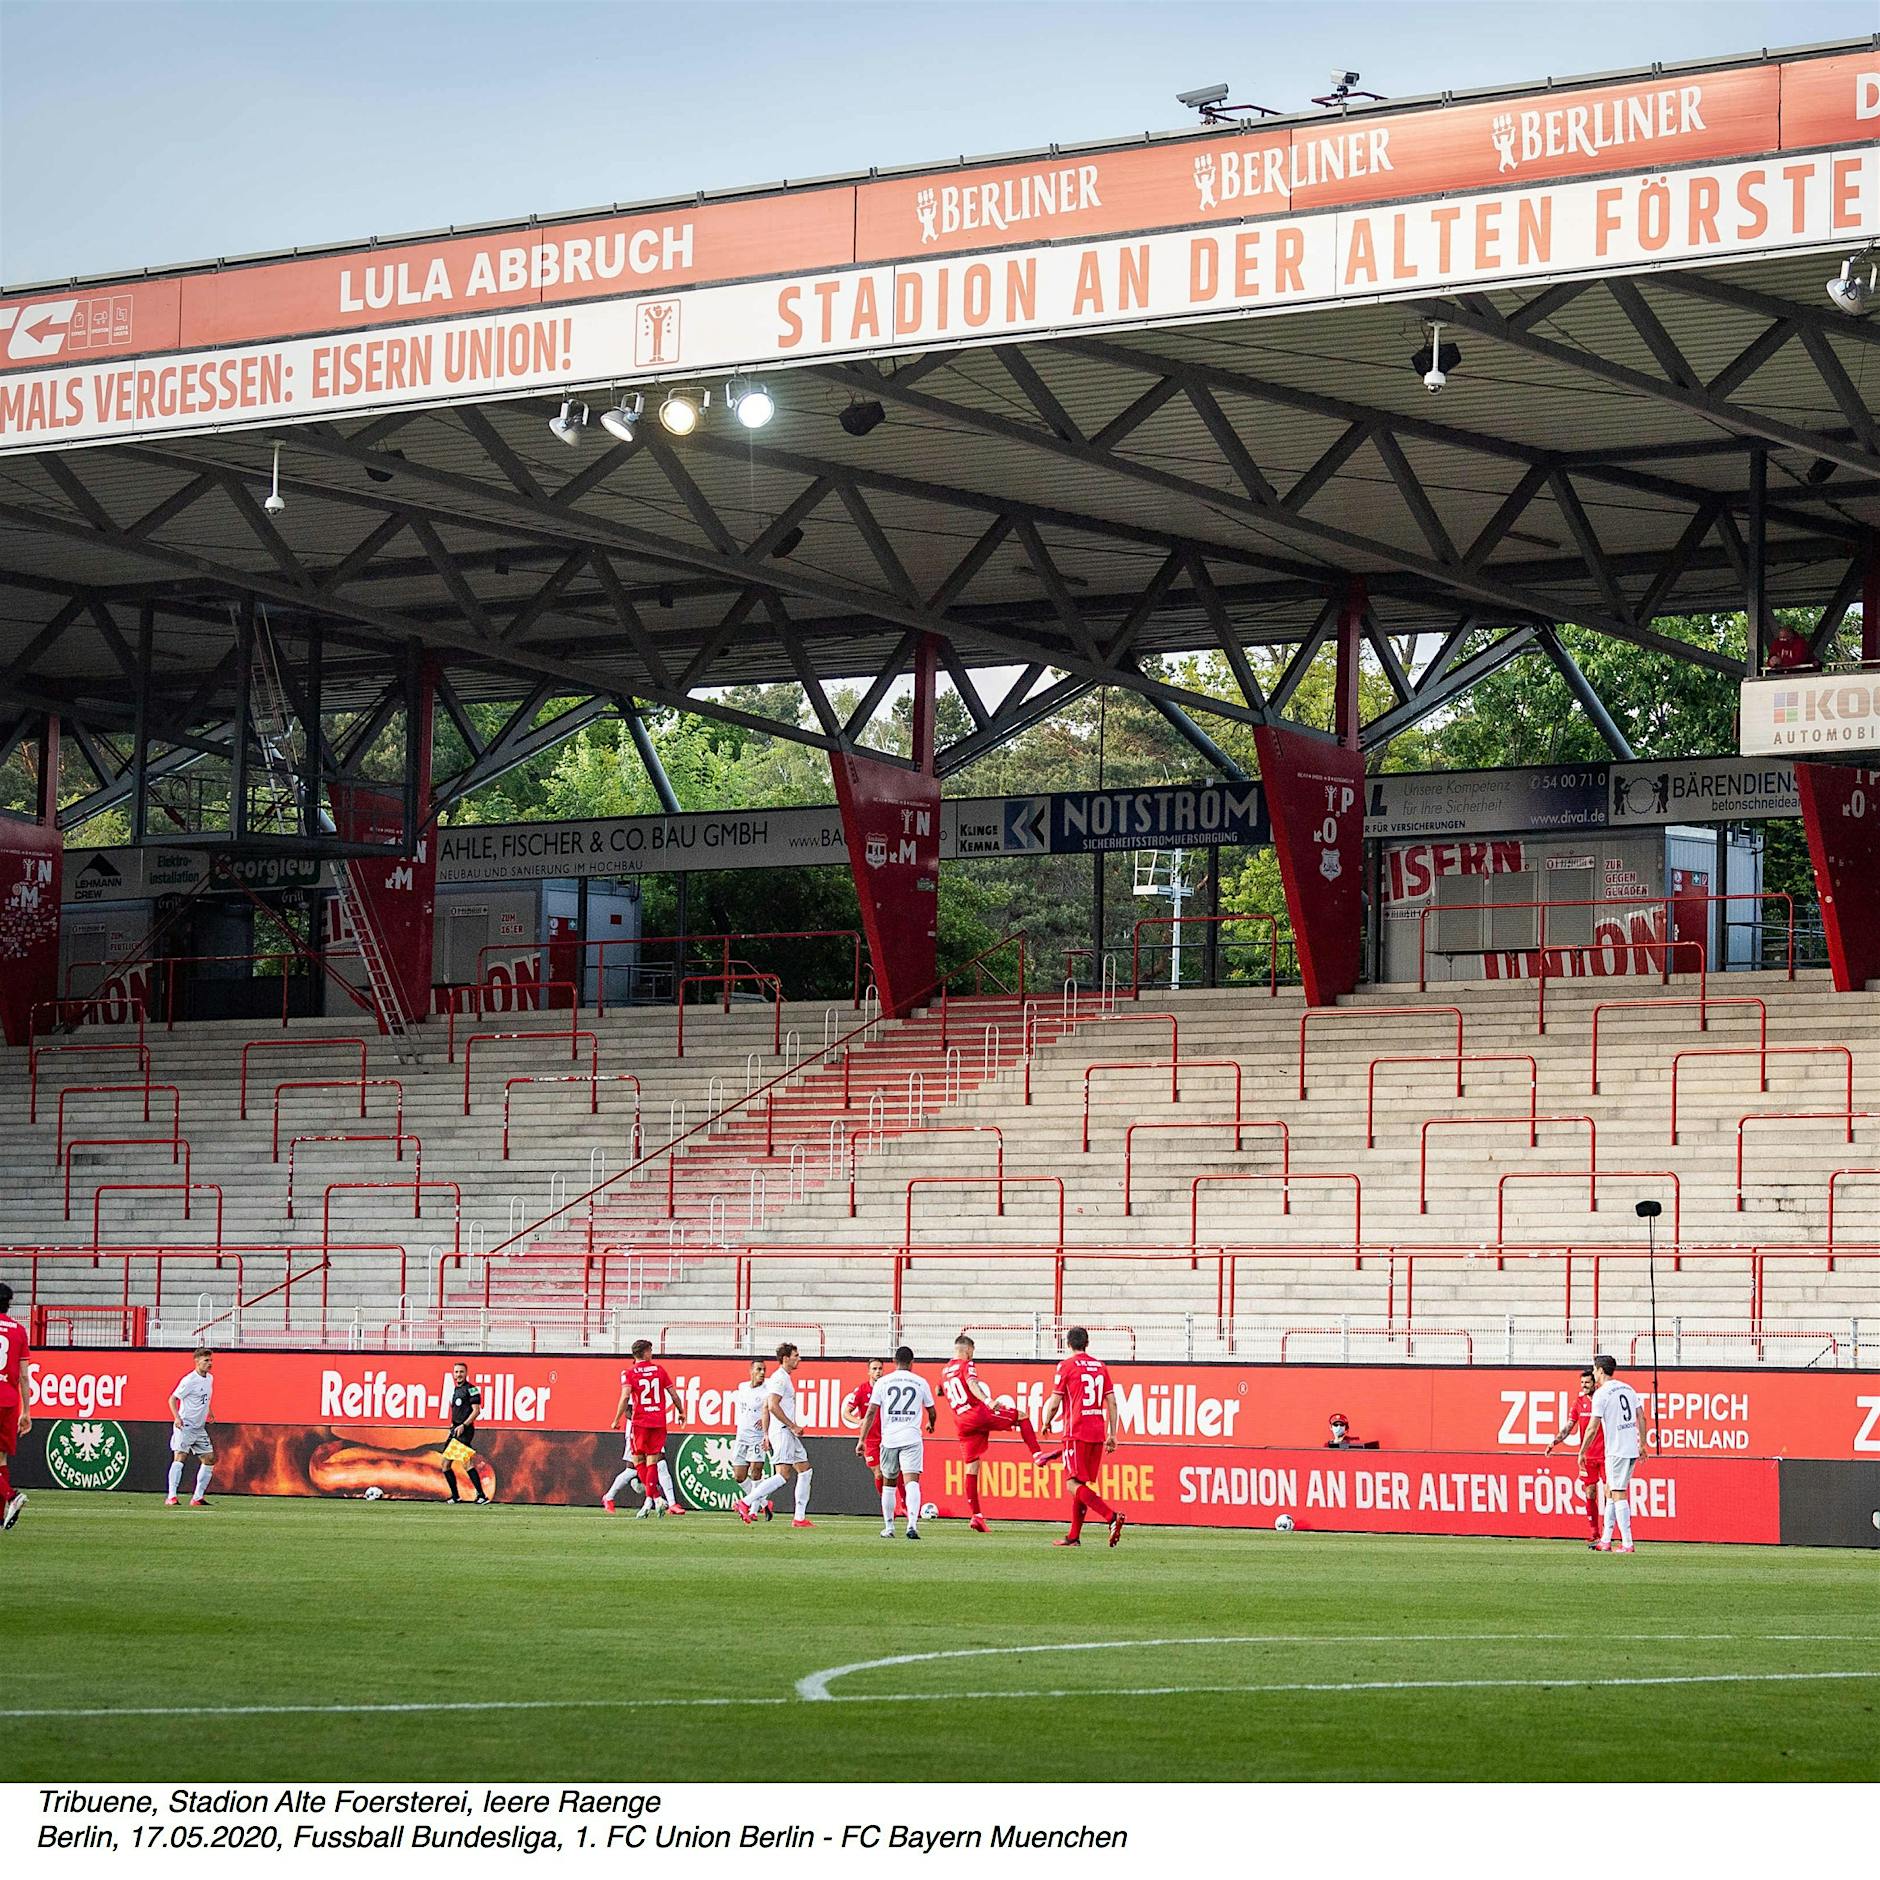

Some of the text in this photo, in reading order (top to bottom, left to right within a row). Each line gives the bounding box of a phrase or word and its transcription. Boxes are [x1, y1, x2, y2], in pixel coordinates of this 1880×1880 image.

[1520, 86, 1706, 161] BERLINER
[1221, 128, 1393, 198] BERLINER
[941, 165, 1102, 232] BERLINER
[777, 158, 1862, 348] STADION AN DER ALTEN FÖRSTE
[340, 224, 694, 312] LULA ABBRUCH
[0, 318, 572, 433] MALS VERGESSEN: EISERN UNION!
[1806, 687, 1880, 721] KO
[1404, 779, 1511, 797] Unsere Kompetenz
[1543, 777, 1557, 789] 54
[1560, 775, 1575, 788] 00
[1402, 799, 1502, 817] für Ihre Sicherheit
[1530, 808, 1605, 825] www.dival.de
[916, 810, 930, 836] N
[1373, 823, 1388, 832] FÜR
[1391, 820, 1466, 832] VERSICHERUNGEN
[440, 836, 498, 863] AHLE,
[502, 831, 584, 857] FISCHER
[590, 830, 604, 853] &
[610, 827, 648, 851] CO.
[652, 825, 696, 849] BAU
[703, 821, 768, 847] GMBH
[899, 839, 917, 865] M
[37, 860, 53, 882] N
[440, 860, 643, 880] NEUBAU UND SANIERUNG IM HOCHBAU
[1605, 860, 1622, 869] ZUR
[1605, 873, 1636, 883] GEGEN
[75, 878, 122, 889] LEHMANN
[75, 890, 103, 899] CREW
[1605, 886, 1648, 897] GERADEN
[28, 1363, 127, 1418] Seeger
[638, 1377, 661, 1405] 21
[888, 1386, 917, 1415] 22
[1080, 1373, 1105, 1407] 31
[1619, 1394, 1632, 1422] 9
[1644, 1427, 1750, 1450] ODENLAND
[50, 1447, 126, 1489] EBERSWALDER
[945, 1459, 1063, 1499] HNDERT
[1180, 1465, 1297, 1507] STADION
[1306, 1470, 1347, 1508] AN
[1355, 1471, 1411, 1511] DER
[1418, 1473, 1509, 1514] ALTEN
[1518, 1468, 1677, 1519] FÖRSREI
